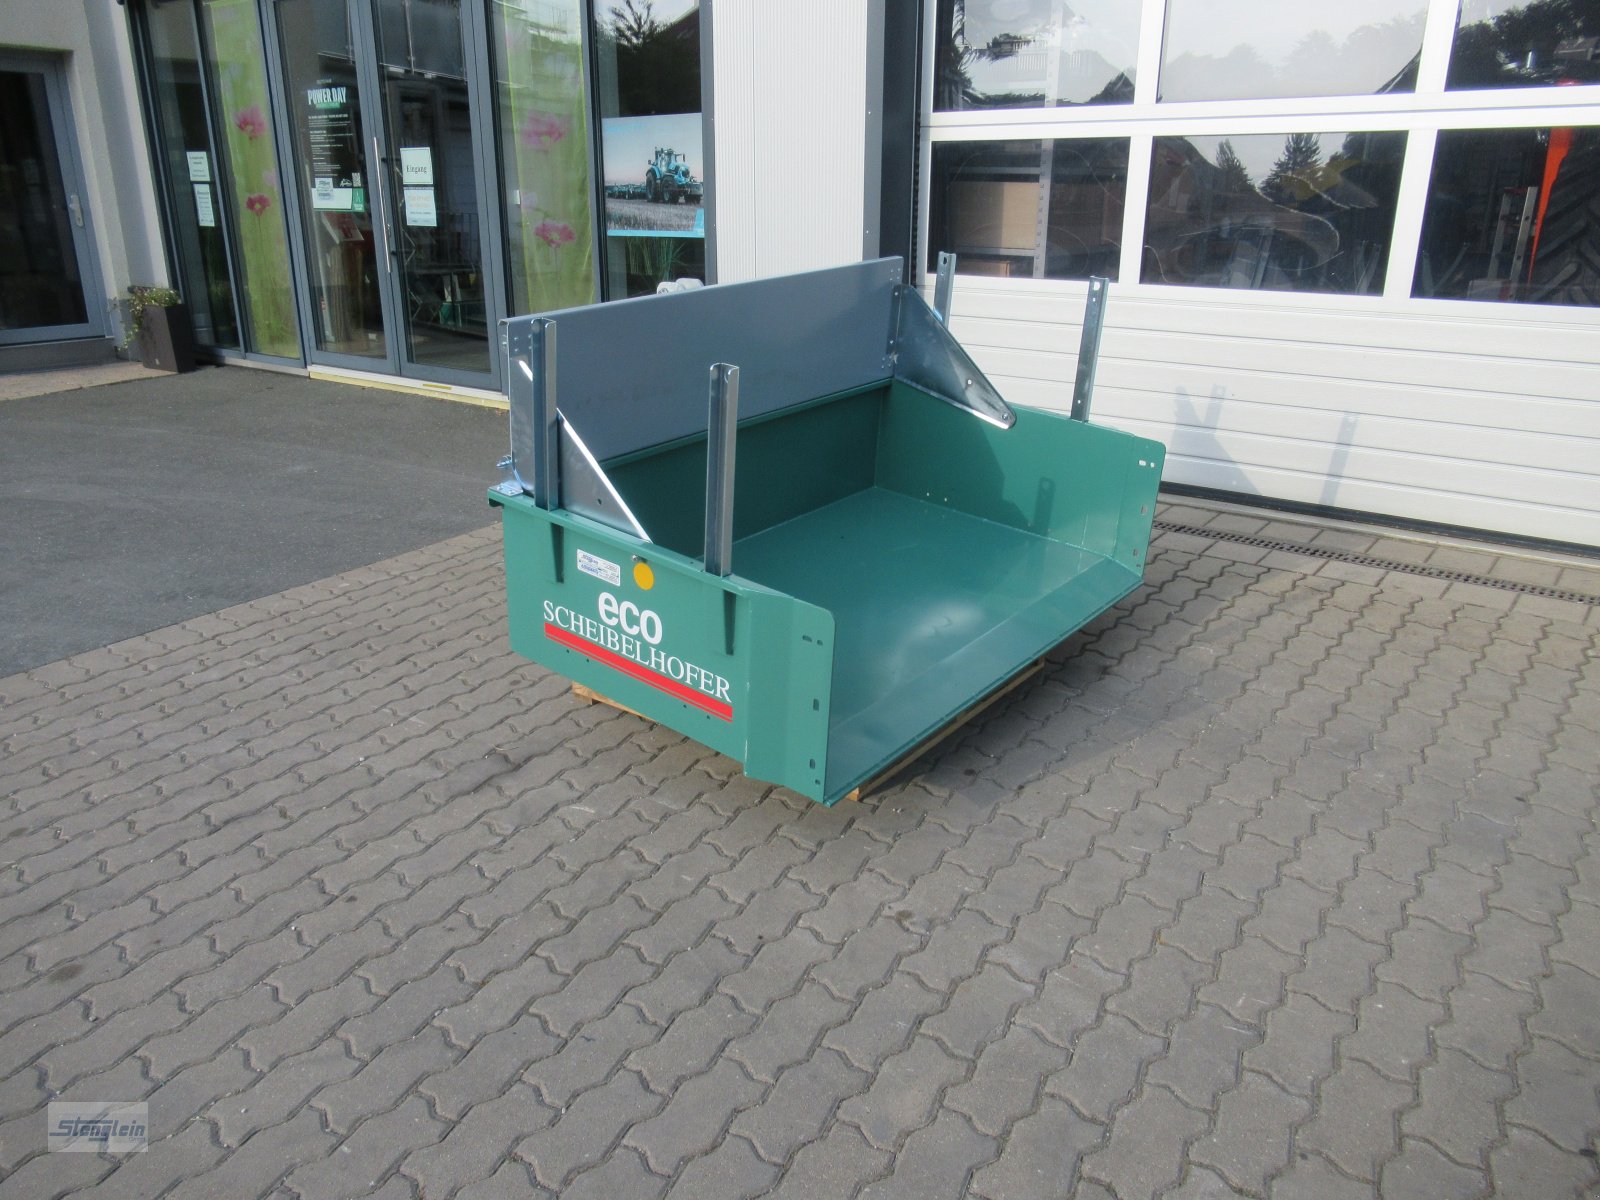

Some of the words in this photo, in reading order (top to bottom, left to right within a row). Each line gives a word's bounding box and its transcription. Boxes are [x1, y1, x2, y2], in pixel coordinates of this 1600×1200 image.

[307, 88, 332, 105] POWER
[331, 86, 346, 103] DAY
[406, 164, 428, 174] Eingang
[598, 591, 663, 645] eco
[543, 600, 732, 703] SCHEIBELHOFER
